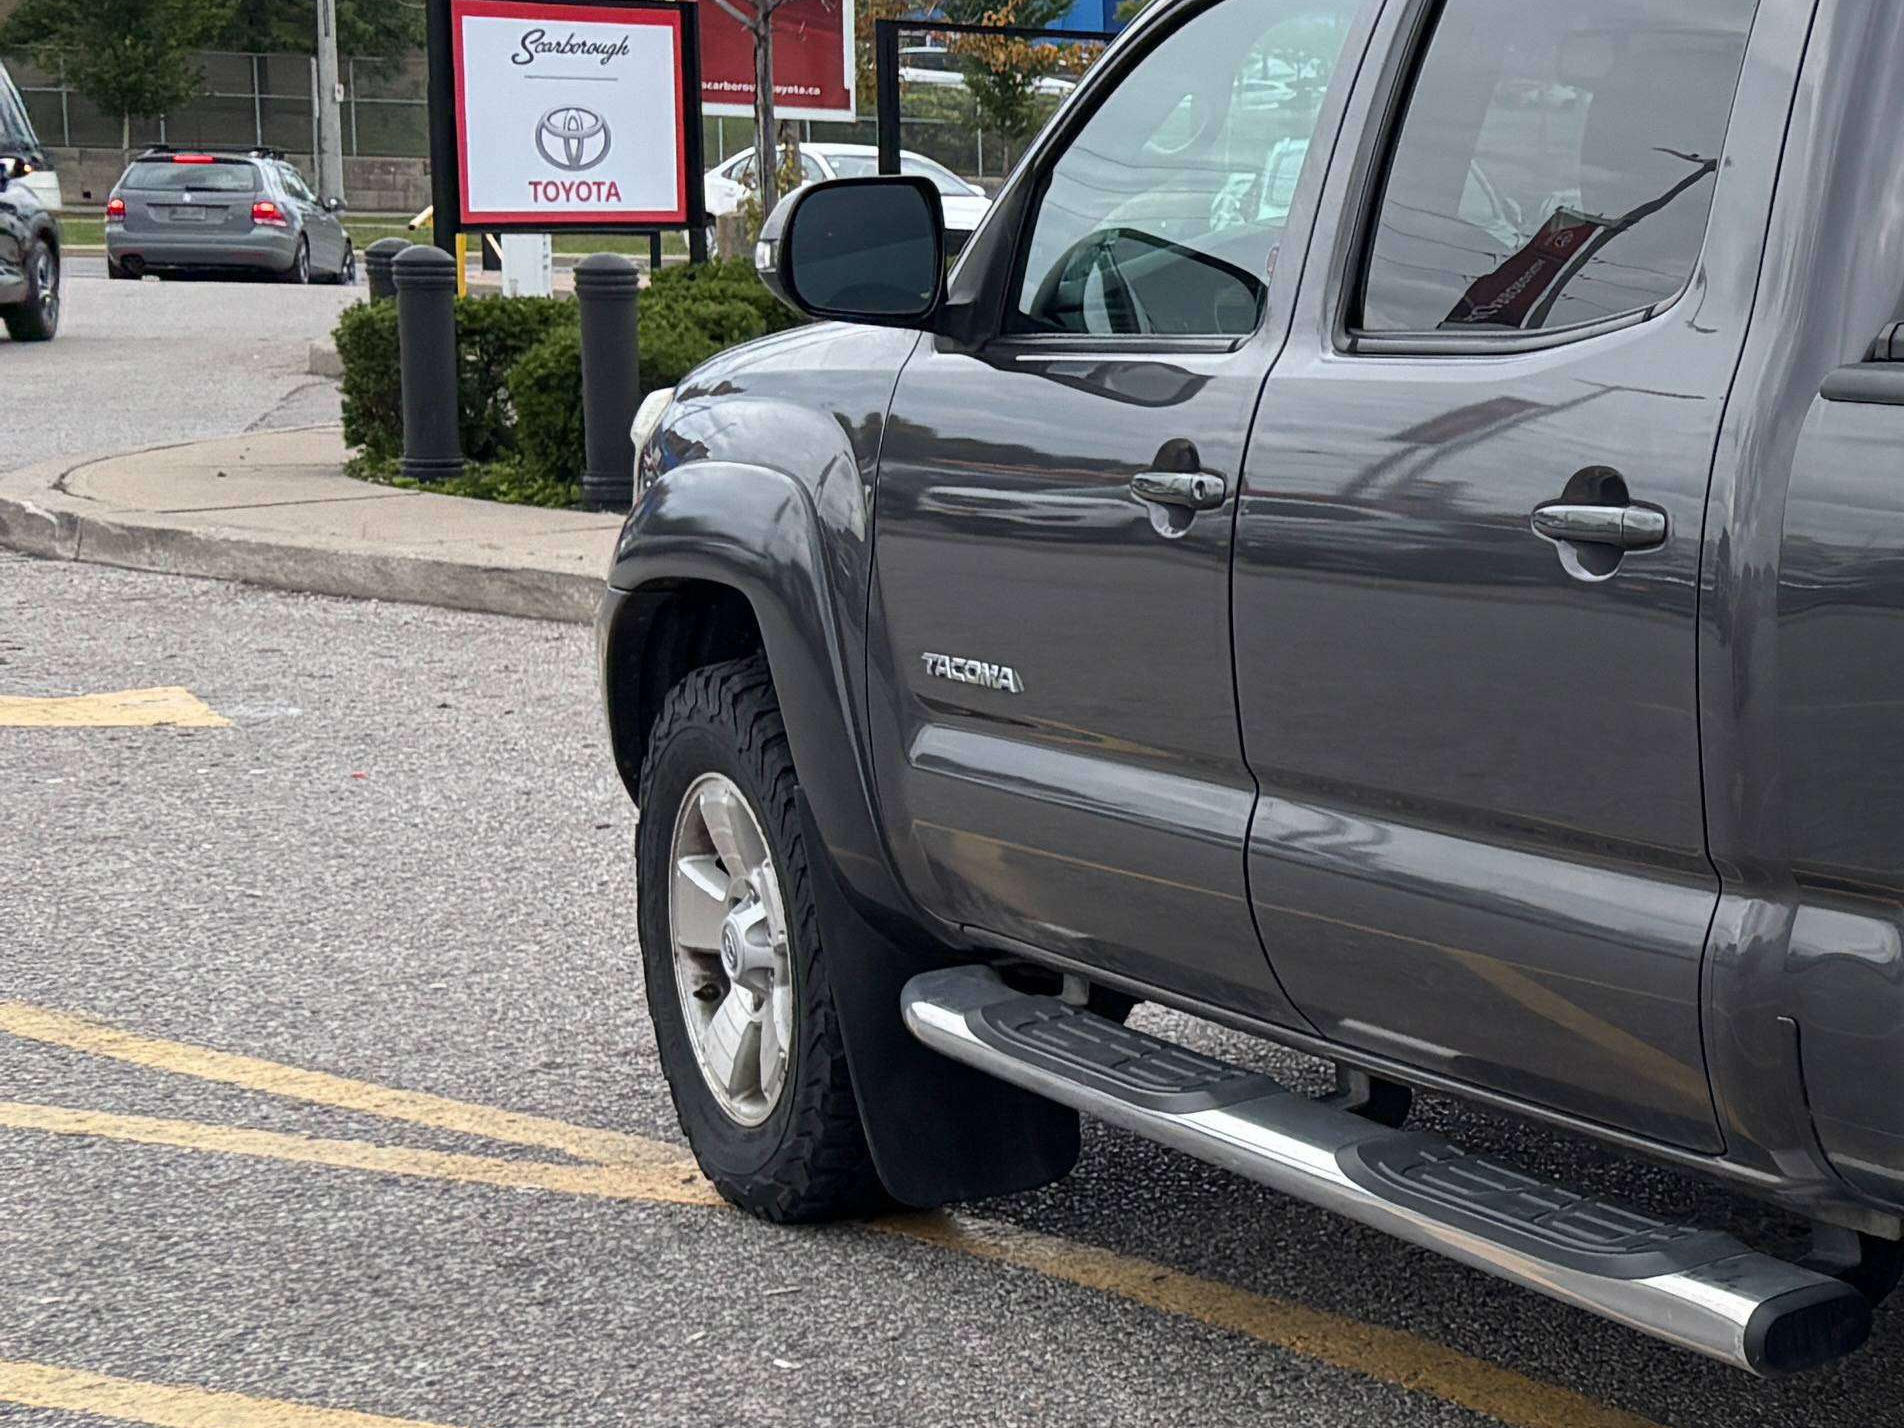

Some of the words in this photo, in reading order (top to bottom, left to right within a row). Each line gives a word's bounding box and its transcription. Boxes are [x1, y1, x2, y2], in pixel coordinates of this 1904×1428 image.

[511, 28, 630, 66] Scarborough
[528, 180, 622, 204] TOYOTA
[921, 651, 1022, 693] TACOMA
